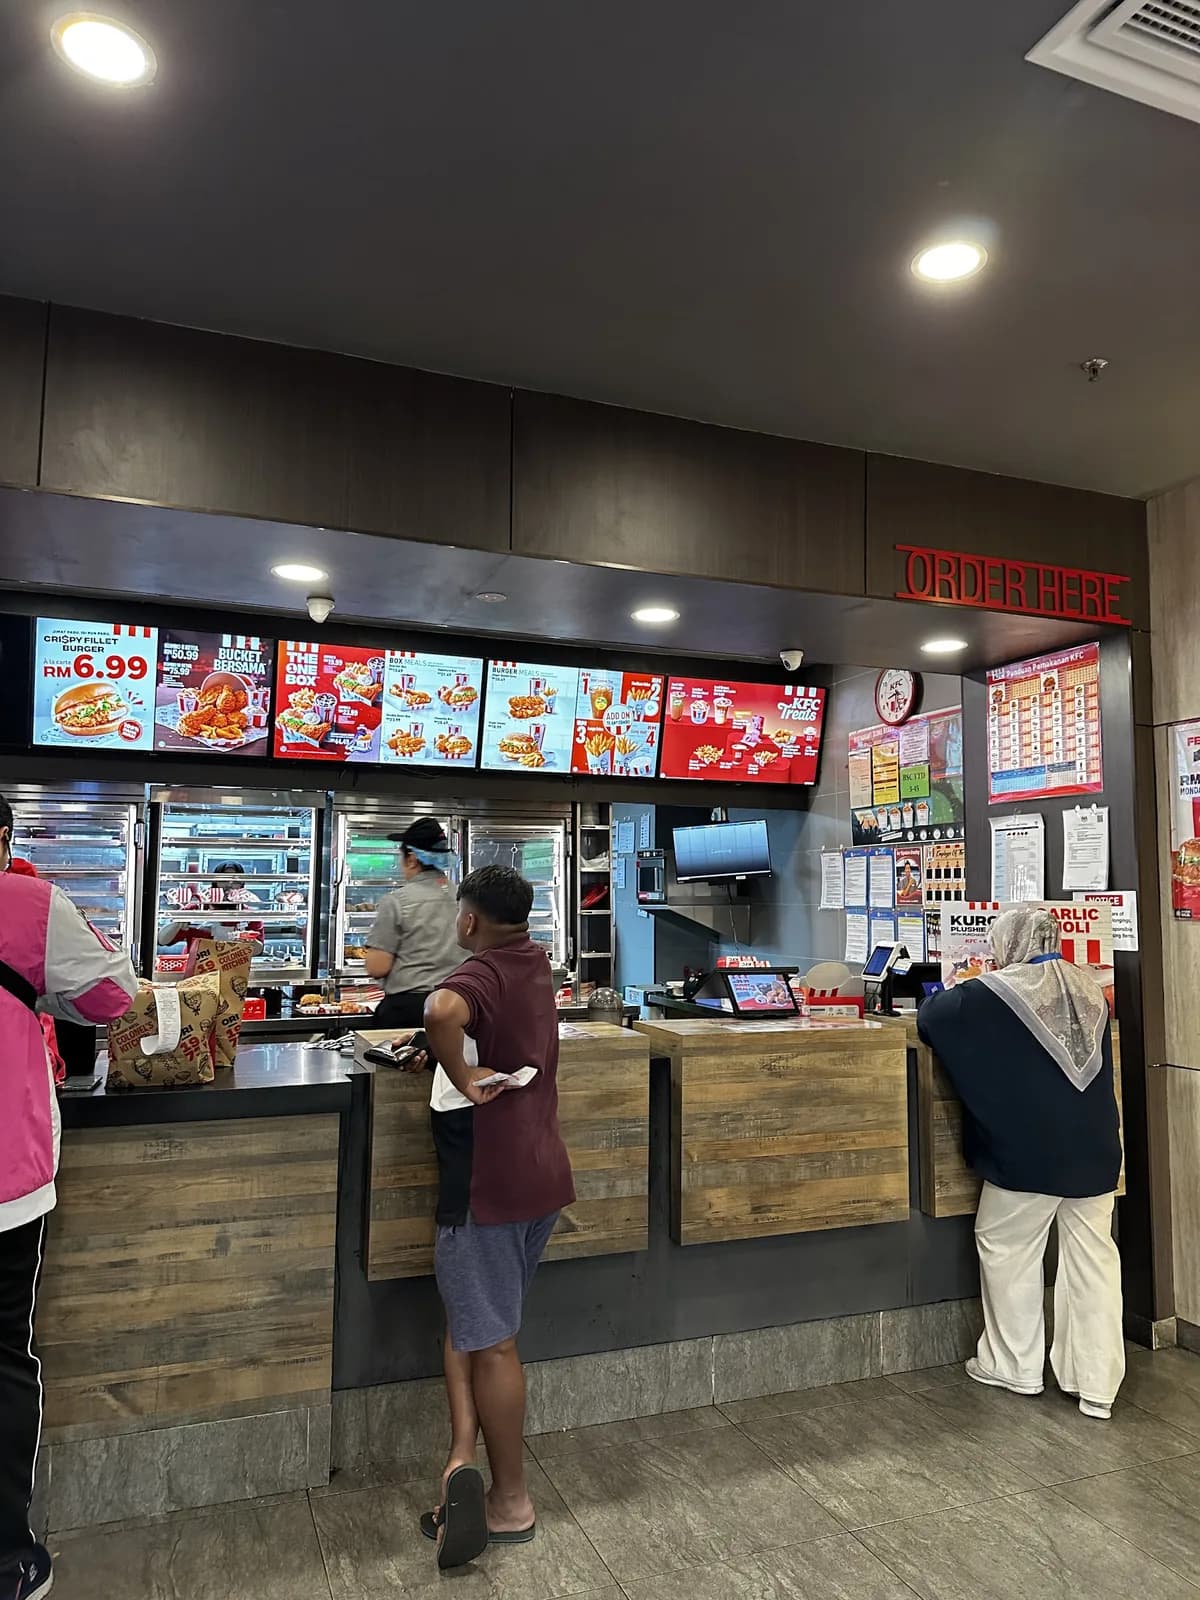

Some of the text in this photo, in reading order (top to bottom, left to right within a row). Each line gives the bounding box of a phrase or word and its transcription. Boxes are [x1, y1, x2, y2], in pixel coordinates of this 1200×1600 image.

[905, 550, 1122, 621] ORDER HERE
[84, 637, 119, 645] FILLET
[62, 645, 105, 653] BURGER
[218, 647, 262, 663] BUCKET
[1070, 651, 1085, 661] KFC
[286, 651, 318, 664] THE
[389, 657, 403, 665] BOX
[404, 659, 428, 667] MEALS
[213, 658, 266, 675] BERSAMA
[492, 667, 518, 675] BURGER
[518, 669, 540, 677] MEALS
[285, 674, 317, 686] BOX
[582, 678, 588, 695] 1
[650, 683, 660, 701] 2
[791, 696, 821, 711] KFC
[606, 711, 630, 720] ADD ON
[777, 702, 817, 721] Treats
[575, 725, 587, 743] 3
[646, 731, 656, 748] 4
[1088, 896, 1120, 904] NOTICE
[221, 956, 249, 972] KITCHEN
[221, 1013, 240, 1026] ORI
[115, 1021, 155, 1045] COLONEL'S
[180, 1023, 194, 1037] RI
